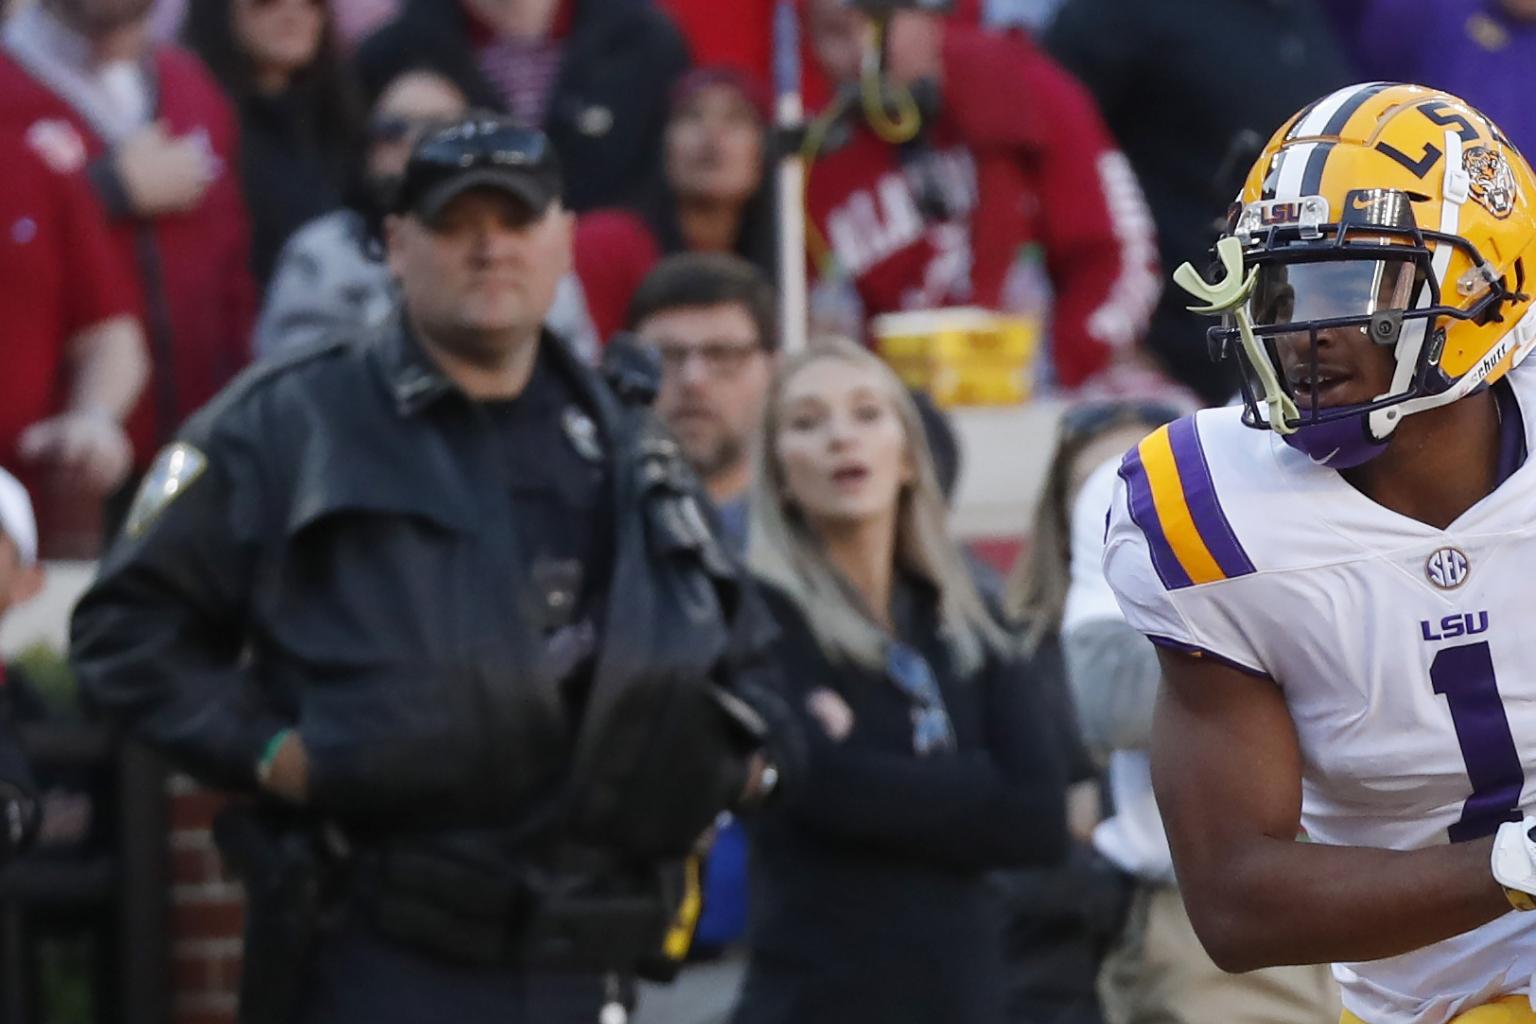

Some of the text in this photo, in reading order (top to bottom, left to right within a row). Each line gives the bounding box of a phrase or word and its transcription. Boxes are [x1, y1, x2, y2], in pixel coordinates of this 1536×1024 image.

[1374, 102, 1518, 179] LS
[1260, 202, 1302, 225] LSU
[1426, 548, 1468, 588] SEC
[1421, 610, 1489, 641] LSU
[1429, 640, 1525, 843] 1
